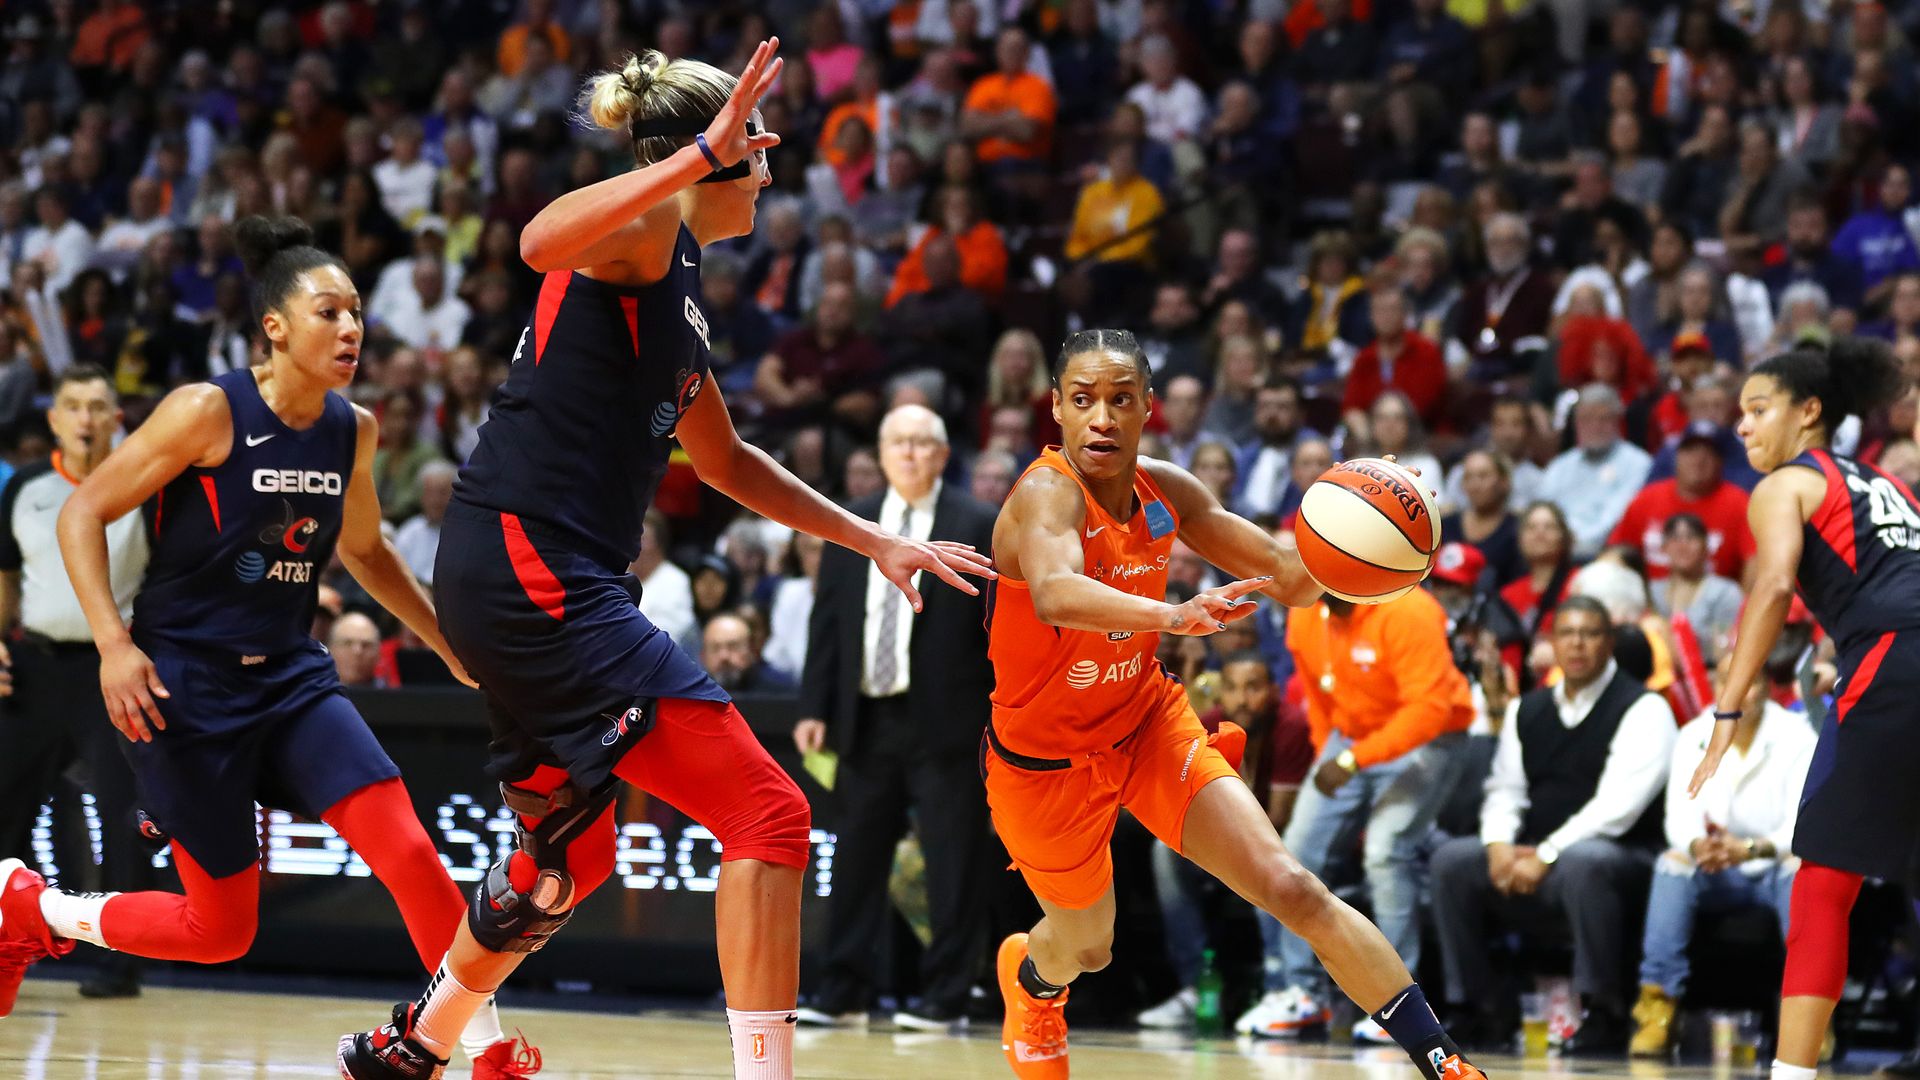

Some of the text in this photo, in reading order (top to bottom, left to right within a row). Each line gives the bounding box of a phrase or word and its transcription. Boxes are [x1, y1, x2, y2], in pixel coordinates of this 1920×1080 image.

[252, 468, 342, 496] GEICO
[266, 560, 314, 583] AT&T
[1111, 562, 1156, 581] Mohegan
[1110, 631, 1133, 641] SUN
[1101, 651, 1142, 684] AT&T
